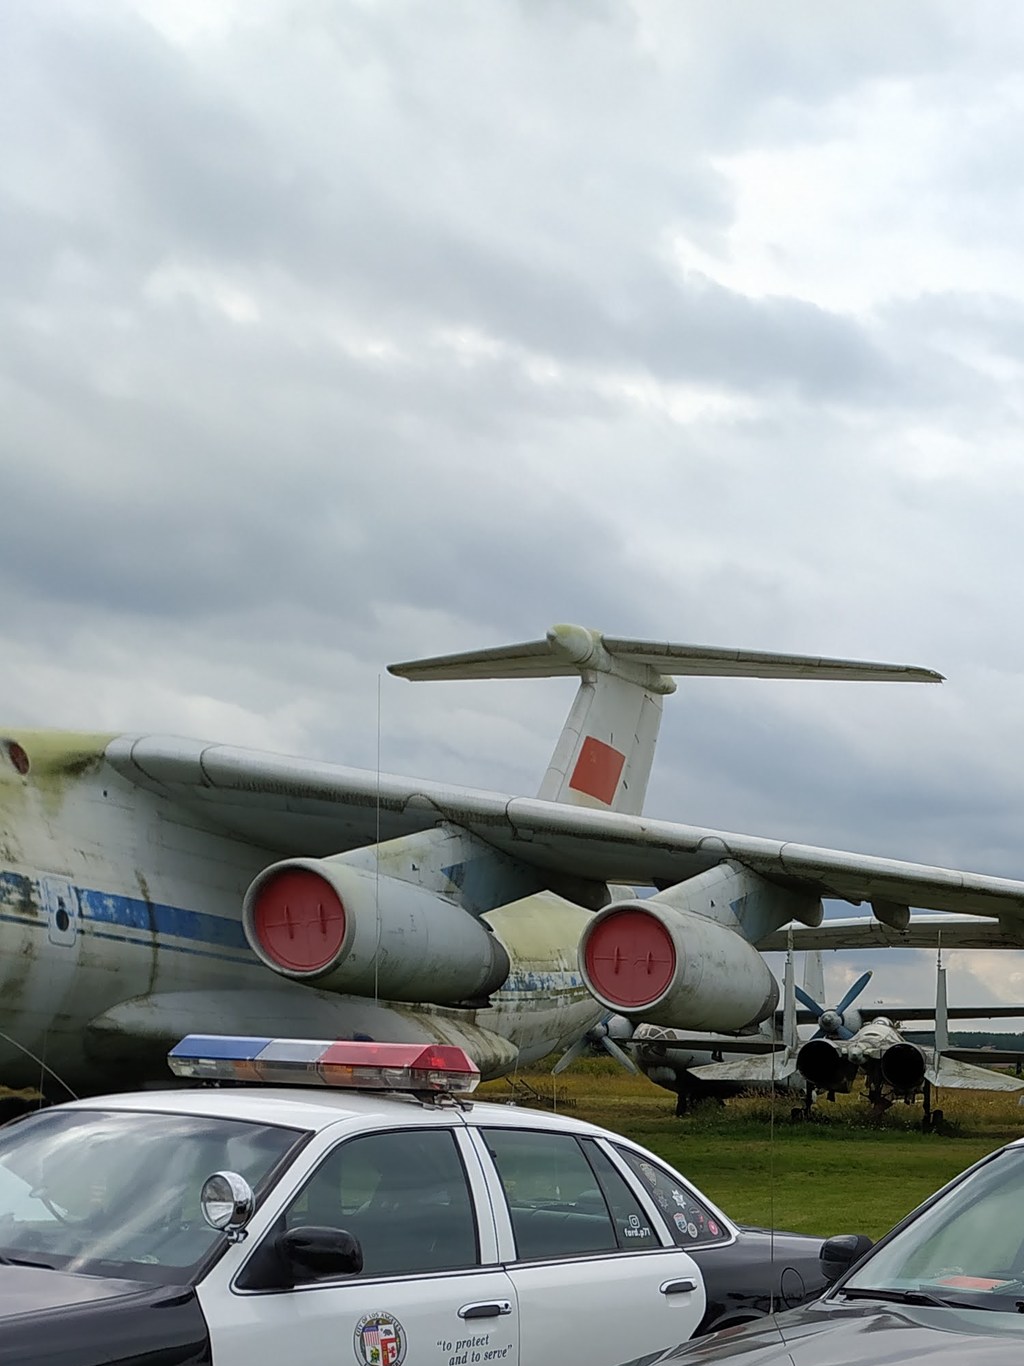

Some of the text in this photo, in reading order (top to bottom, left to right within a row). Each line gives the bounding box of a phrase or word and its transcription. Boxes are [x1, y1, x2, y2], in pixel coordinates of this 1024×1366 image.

[455, 1334, 490, 1353] protect
[449, 1351, 468, 1366] and
[471, 1351, 481, 1363] to
